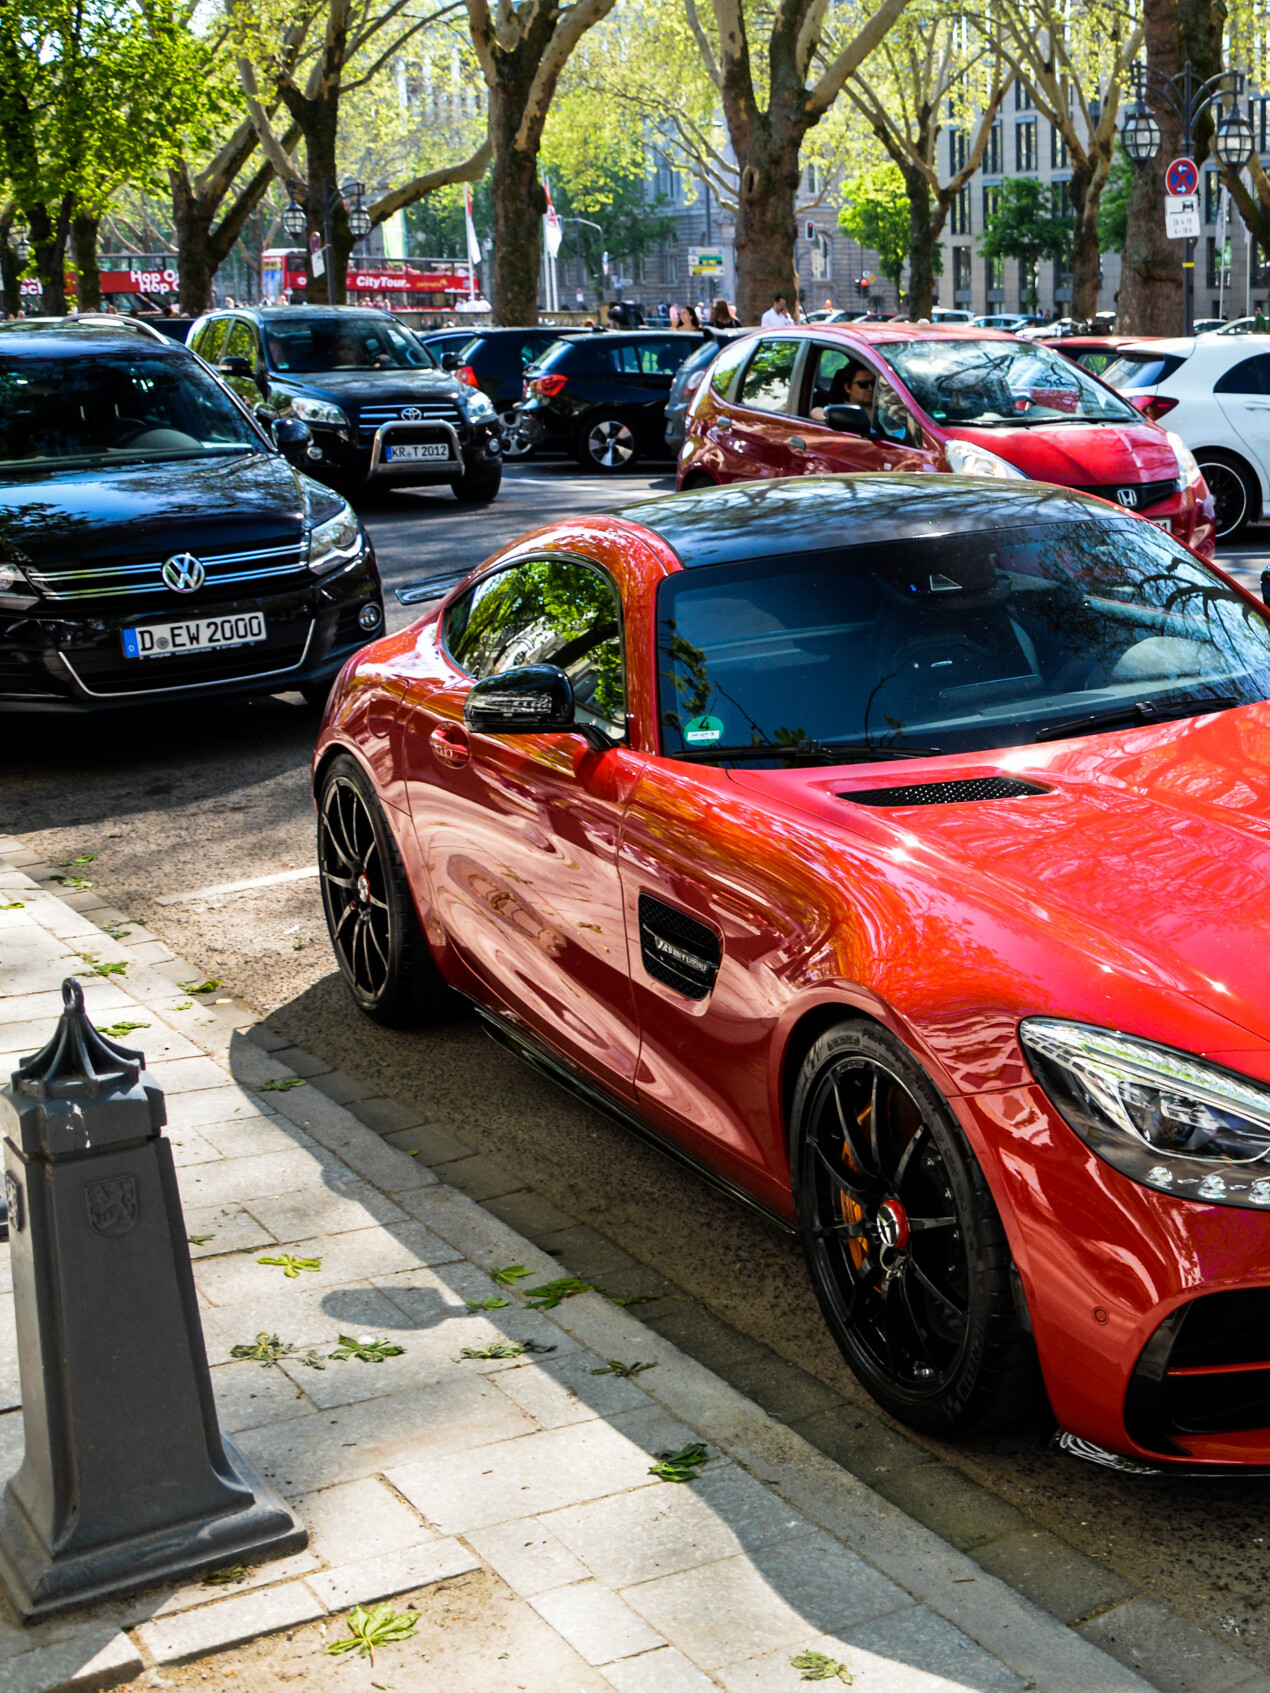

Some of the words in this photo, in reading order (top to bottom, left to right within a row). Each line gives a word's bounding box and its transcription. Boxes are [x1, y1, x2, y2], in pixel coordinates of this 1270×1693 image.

[130, 270, 161, 284] Hop
[392, 446, 406, 457] KR
[412, 446, 419, 457] T
[421, 445, 447, 457] 2012
[138, 629, 154, 652] D
[170, 624, 200, 648] EW
[206, 615, 262, 643] 2000
